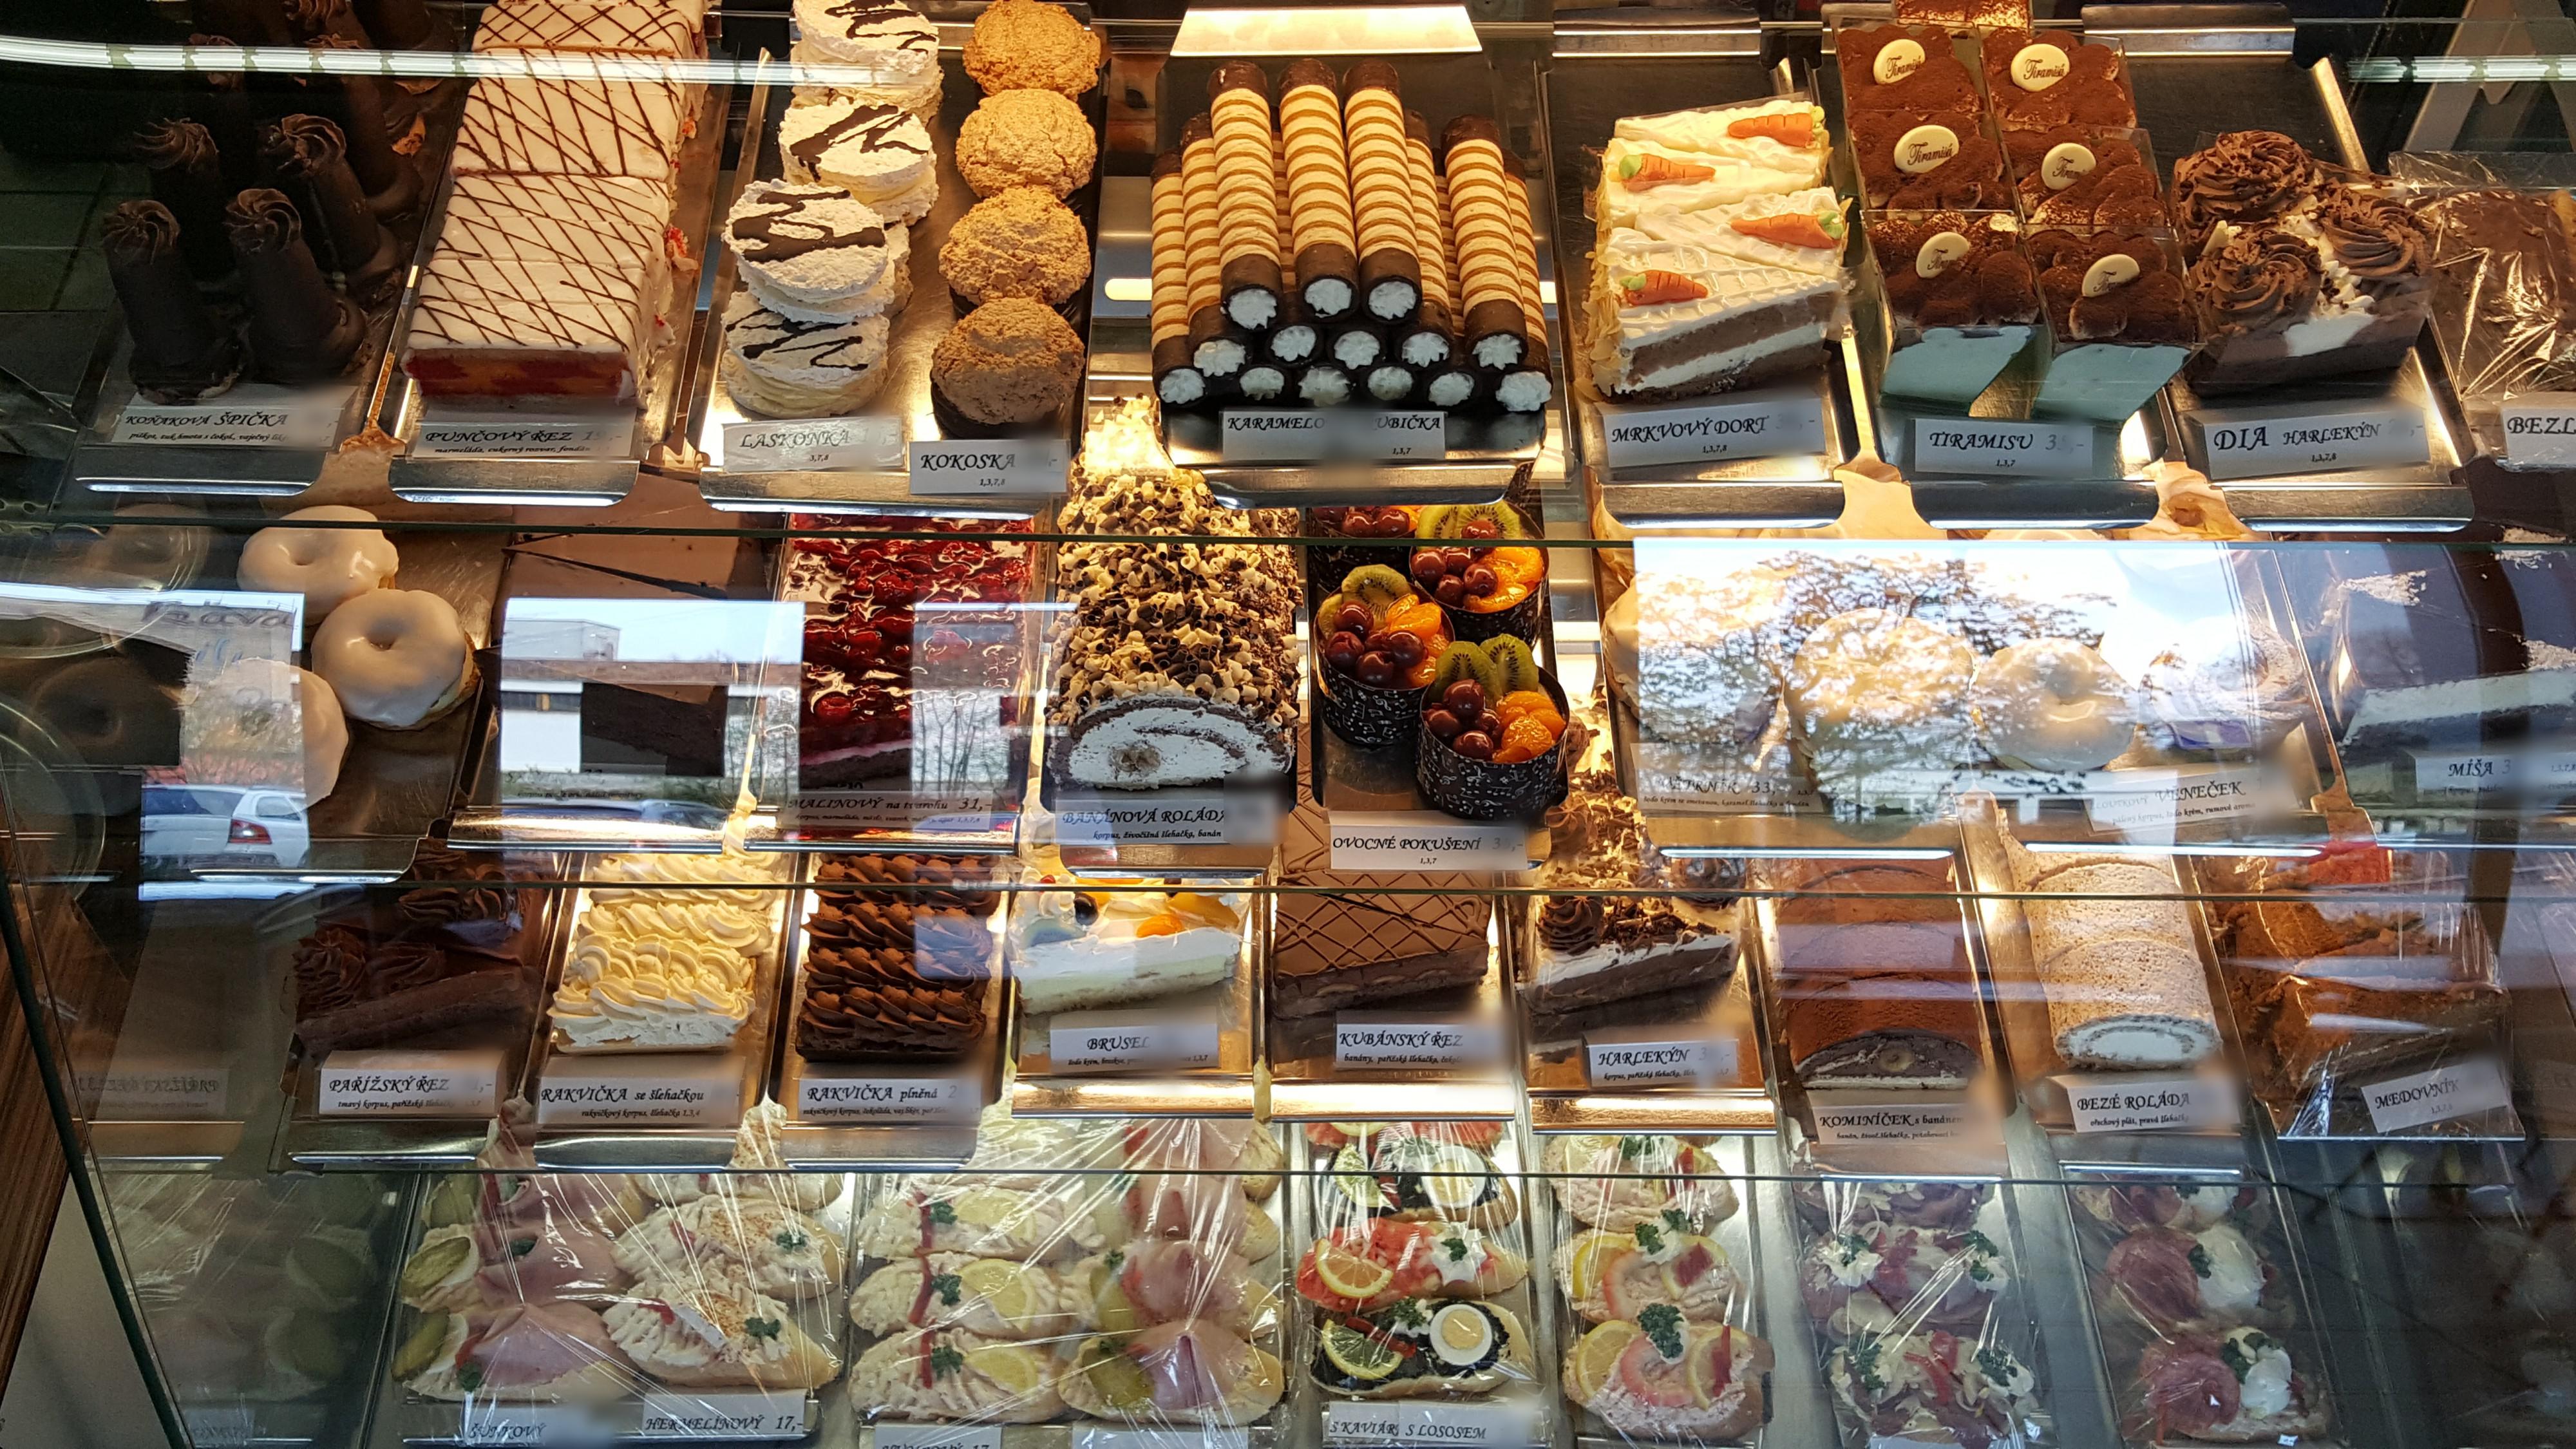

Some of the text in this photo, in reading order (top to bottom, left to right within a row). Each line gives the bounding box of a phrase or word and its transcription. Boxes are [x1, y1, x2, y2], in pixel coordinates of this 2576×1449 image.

[214, 412, 289, 427] ŠPIČKA
[1227, 414, 1442, 431] KARAMELO UBIČKA
[2507, 416, 2576, 435] BEZL
[425, 430, 529, 442] PUNČOVÝ
[531, 430, 573, 442] ŘEZ
[1611, 417, 1713, 444] MRKVOVÝ
[1714, 415, 1770, 435] DORT
[2213, 426, 2269, 451] DIA
[2282, 421, 2382, 446] HARLEKÝN
[1702, 444, 1727, 453] 1,3,7,8
[1929, 431, 2034, 451] TIRAMISU
[809, 453, 829, 462] 3,7,8
[920, 452, 1016, 470] KOKOSKA
[1995, 459, 2016, 468] 1,3,7
[979, 477, 1005, 488] 1,3,7,8
[2447, 758, 2494, 777] MÍŠA
[2154, 780, 2247, 803] VĚNEČEK
[958, 797, 993, 812] 31,-
[1063, 807, 1157, 824] BANÁNOVÁ
[1198, 829, 1222, 838] banán
[1332, 836, 1523, 852] OVOCNÉ POKUŠENÍ 3,-
[1339, 1030, 1463, 1048] KUBÁNSKÝ ŘEZ
[1598, 1046, 1690, 1066] HARLEKÝN
[329, 1075, 415, 1093] PAŘÍŽSKÝ
[415, 1075, 450, 1093] ŘEZ
[541, 1084, 705, 1103] RAKVIČKA se šlehačkou
[807, 1084, 893, 1102] RAKVIČKA
[899, 1087, 938, 1103] plněná
[2374, 1077, 2461, 1110] MEDOVNÍK
[2077, 1094, 2121, 1111] BEZÉ
[1819, 1112, 1915, 1128] KOMINÍČEK
[1922, 1114, 1964, 1124] banáne
[645, 1414, 804, 1432] HERMELÍNOVÝ 17,-
[1330, 1421, 1340, 1434] S
[1405, 1424, 1487, 1439] S LOSOSEM
